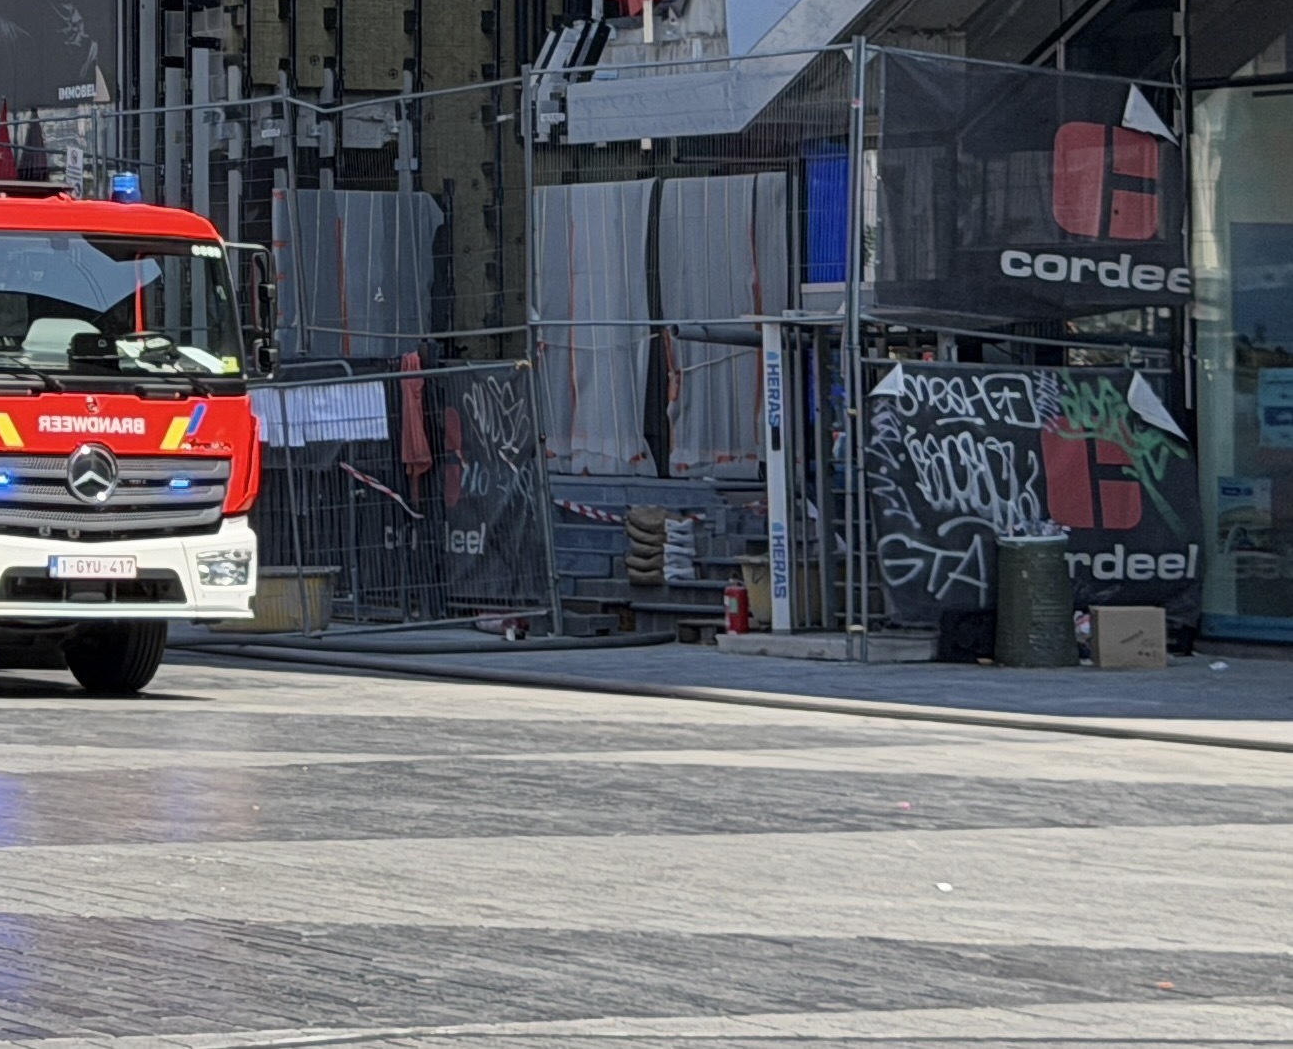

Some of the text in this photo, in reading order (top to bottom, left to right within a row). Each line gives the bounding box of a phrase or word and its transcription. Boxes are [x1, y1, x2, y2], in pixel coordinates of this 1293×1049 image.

[999, 249, 1193, 294] cordee
[766, 363, 782, 427] HERAS
[61, 557, 134, 575] 1-GYU-417
[771, 534, 787, 599] HERAS
[1064, 543, 1199, 580] rdeel
